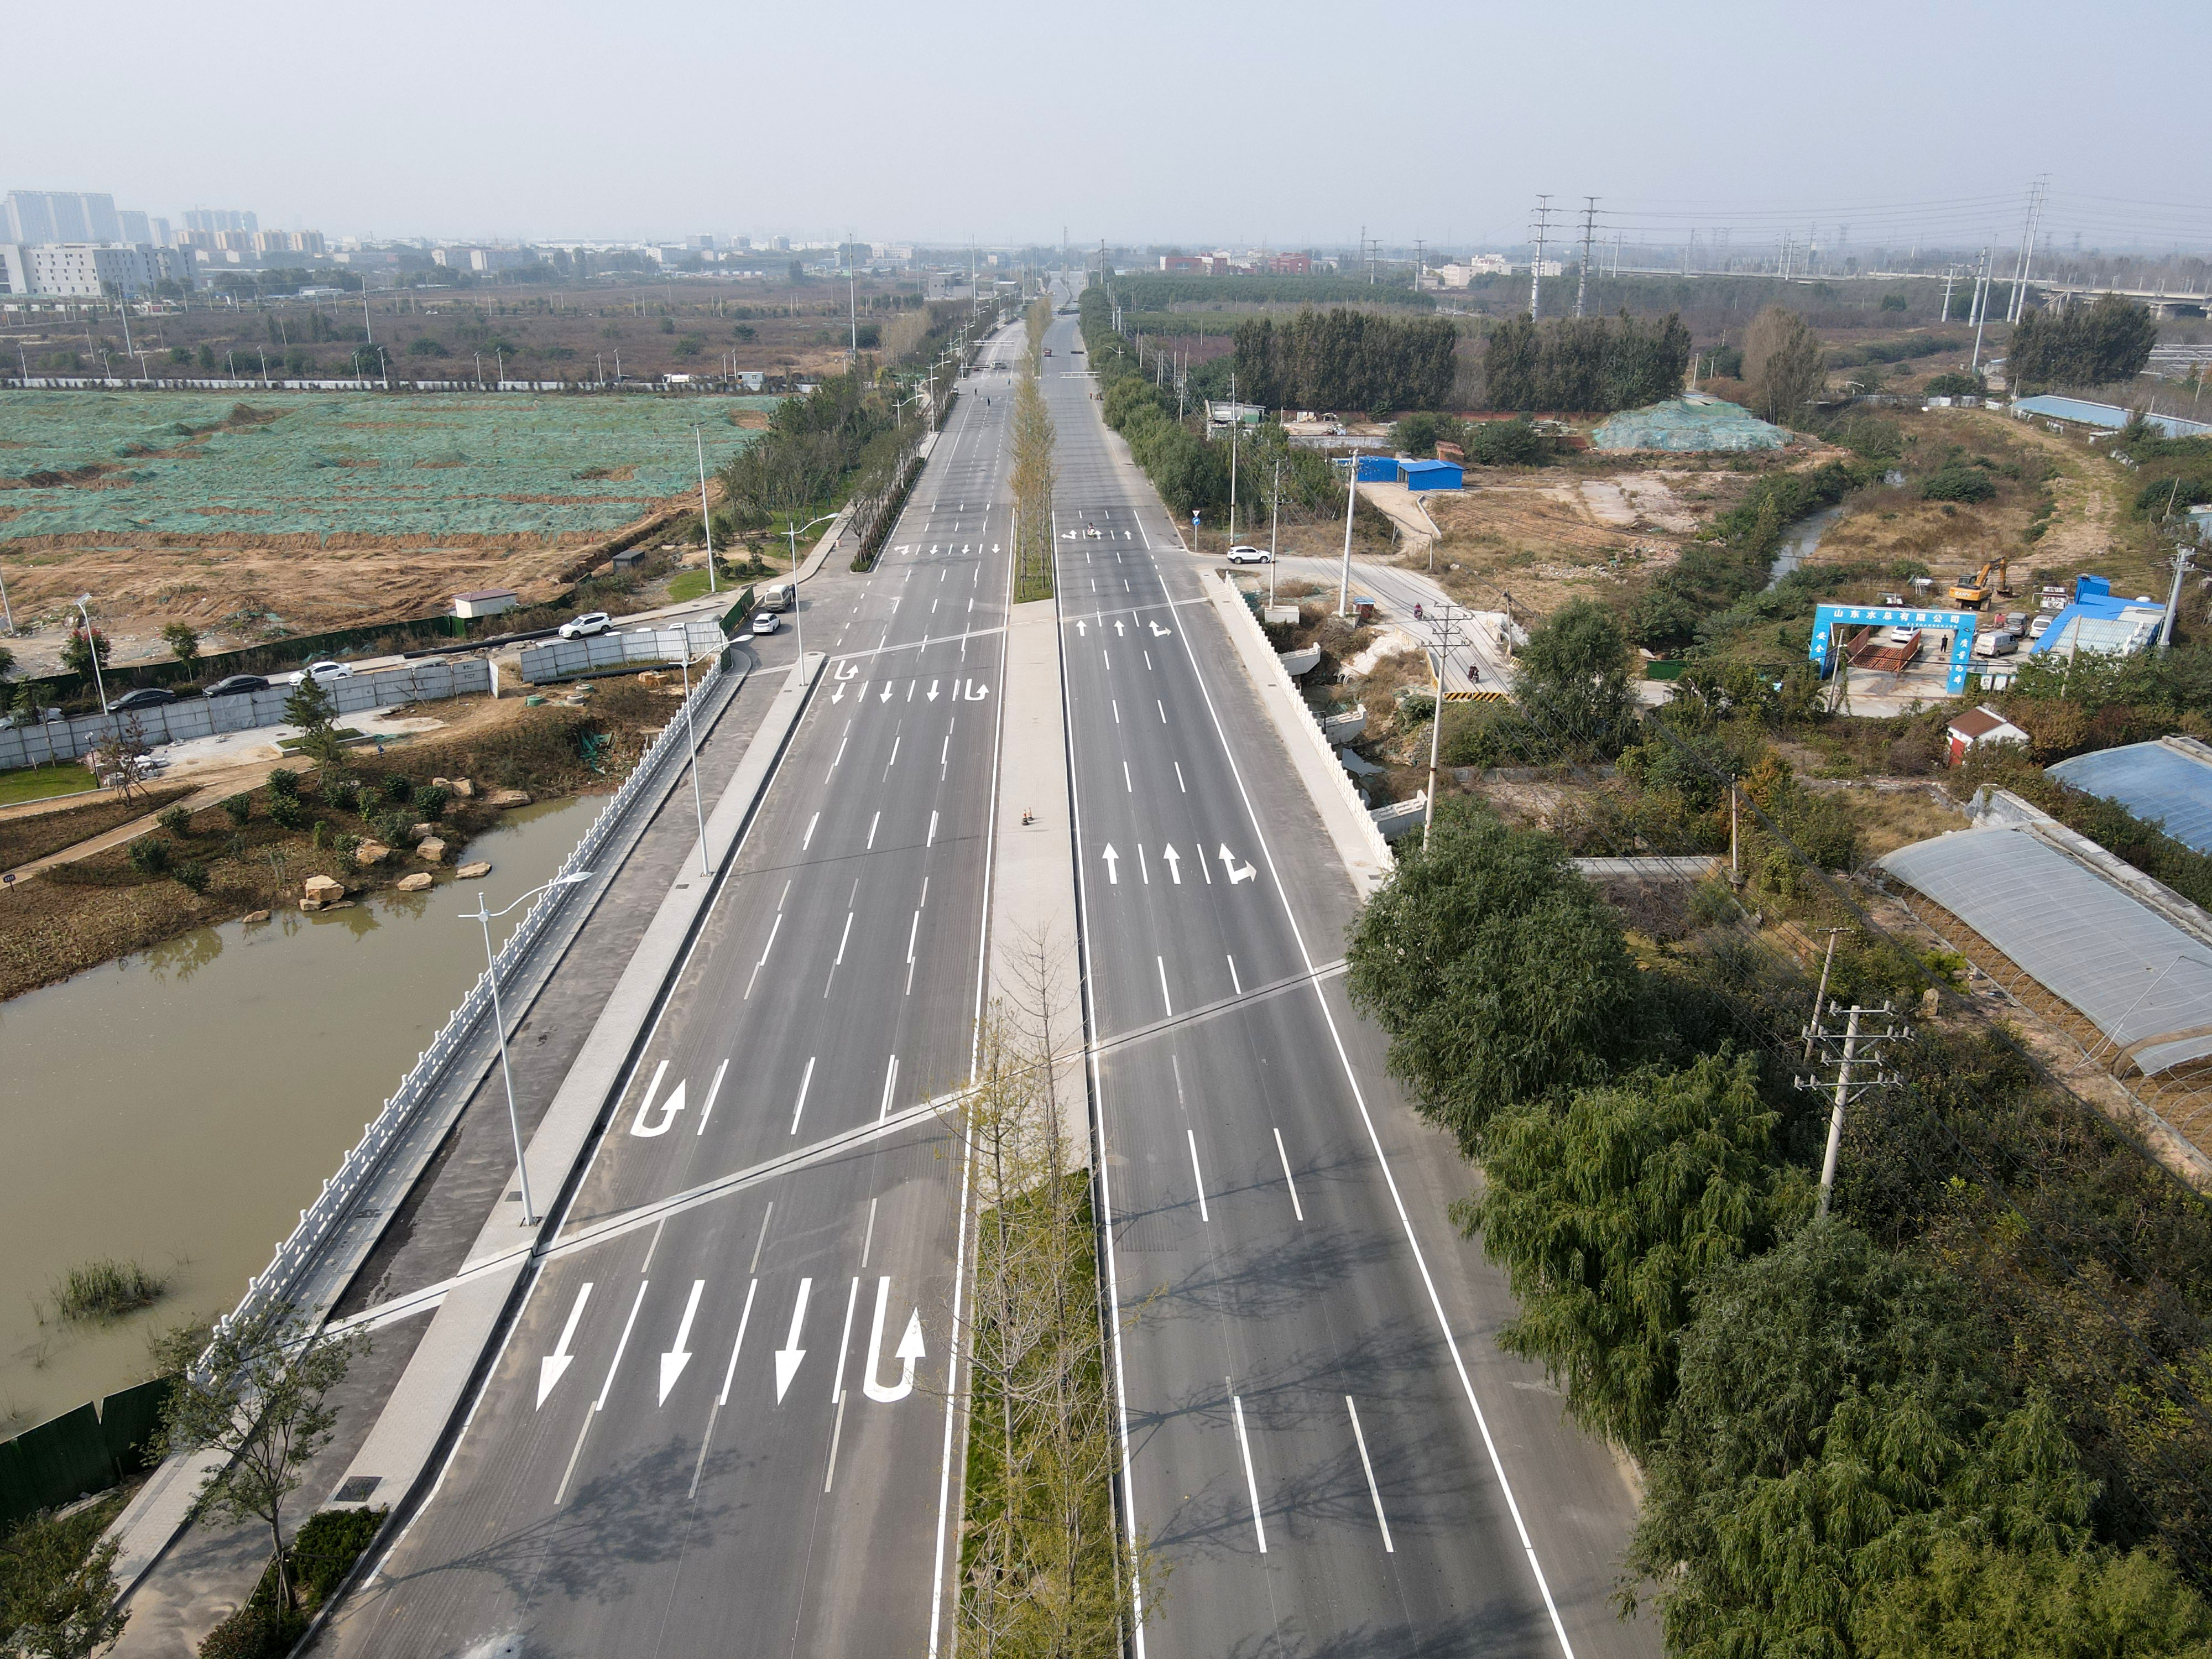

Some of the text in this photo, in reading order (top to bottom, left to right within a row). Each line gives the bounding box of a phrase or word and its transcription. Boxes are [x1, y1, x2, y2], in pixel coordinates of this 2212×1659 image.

[1834, 609, 1959, 624] 山东水总有限公司
